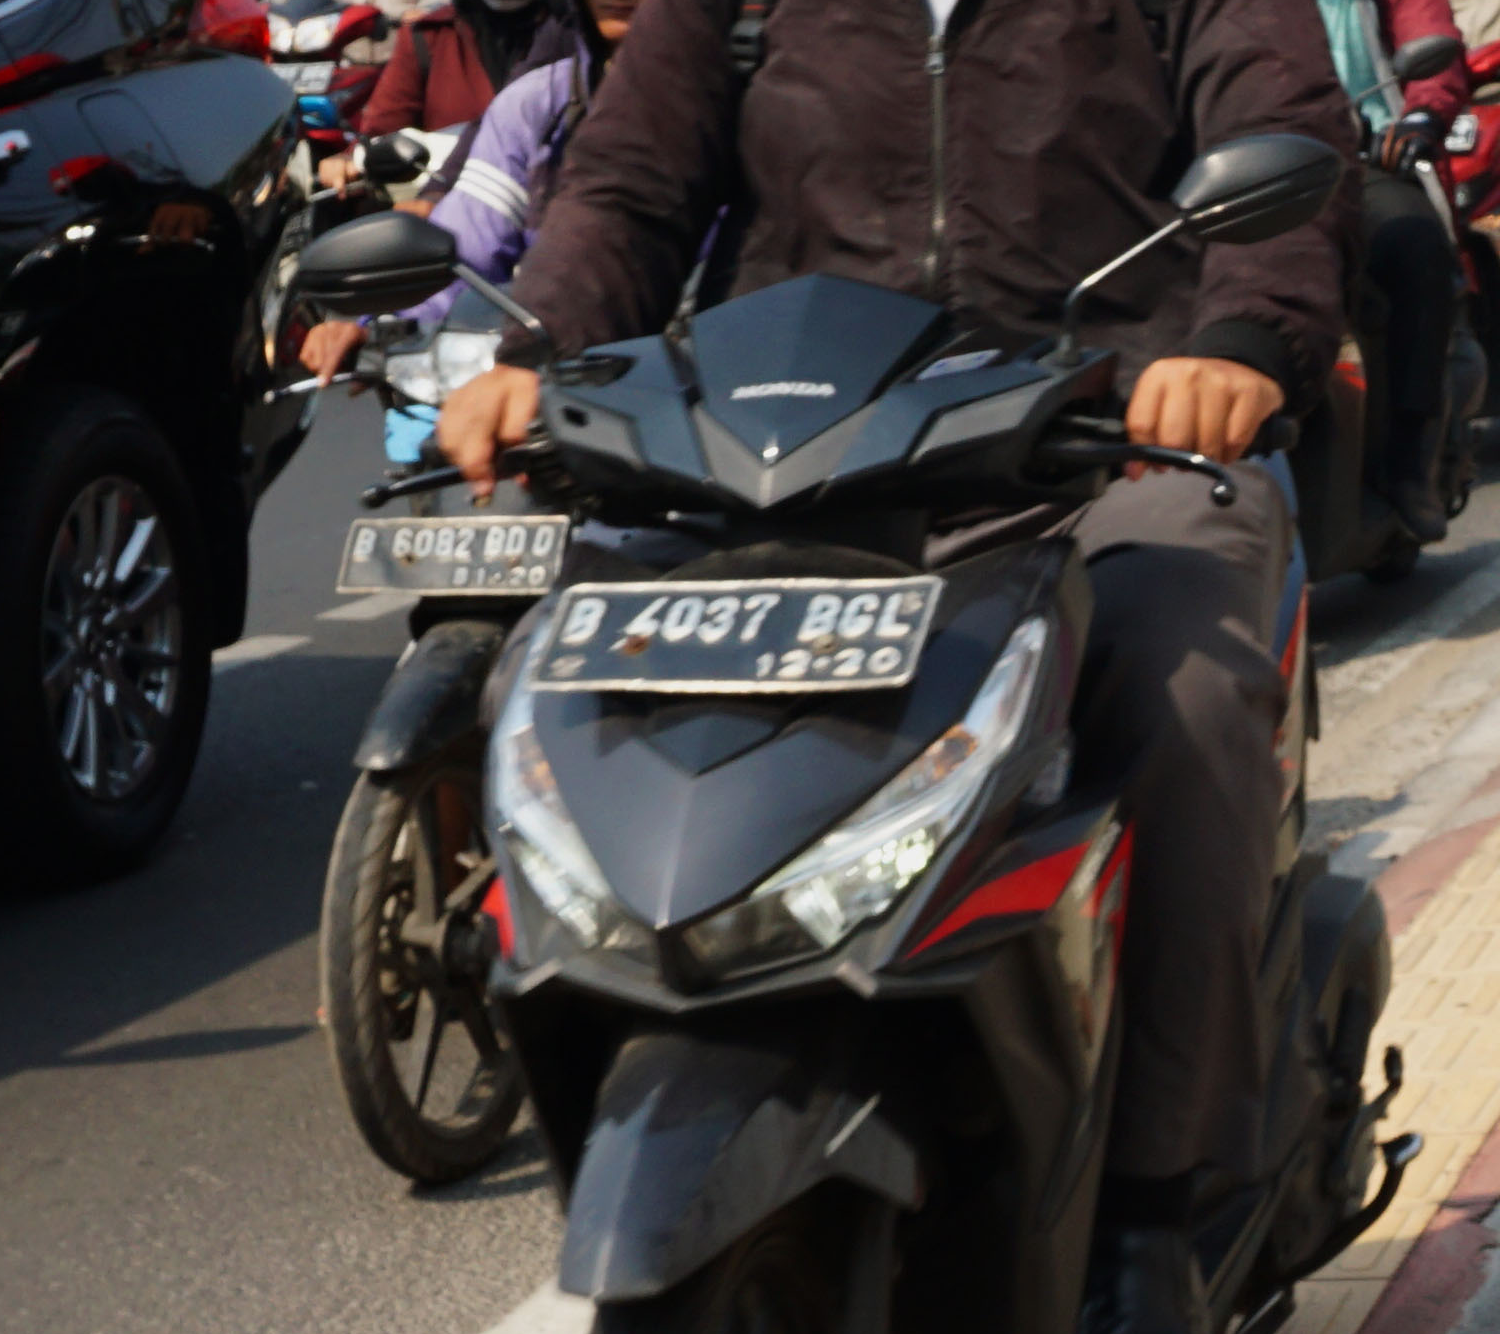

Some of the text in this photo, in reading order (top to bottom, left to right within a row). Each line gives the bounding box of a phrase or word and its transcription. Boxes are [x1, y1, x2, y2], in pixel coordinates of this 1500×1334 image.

[353, 526, 378, 563] B
[392, 525, 476, 563] 6082
[560, 596, 608, 645] B
[609, 593, 782, 652] 4037
